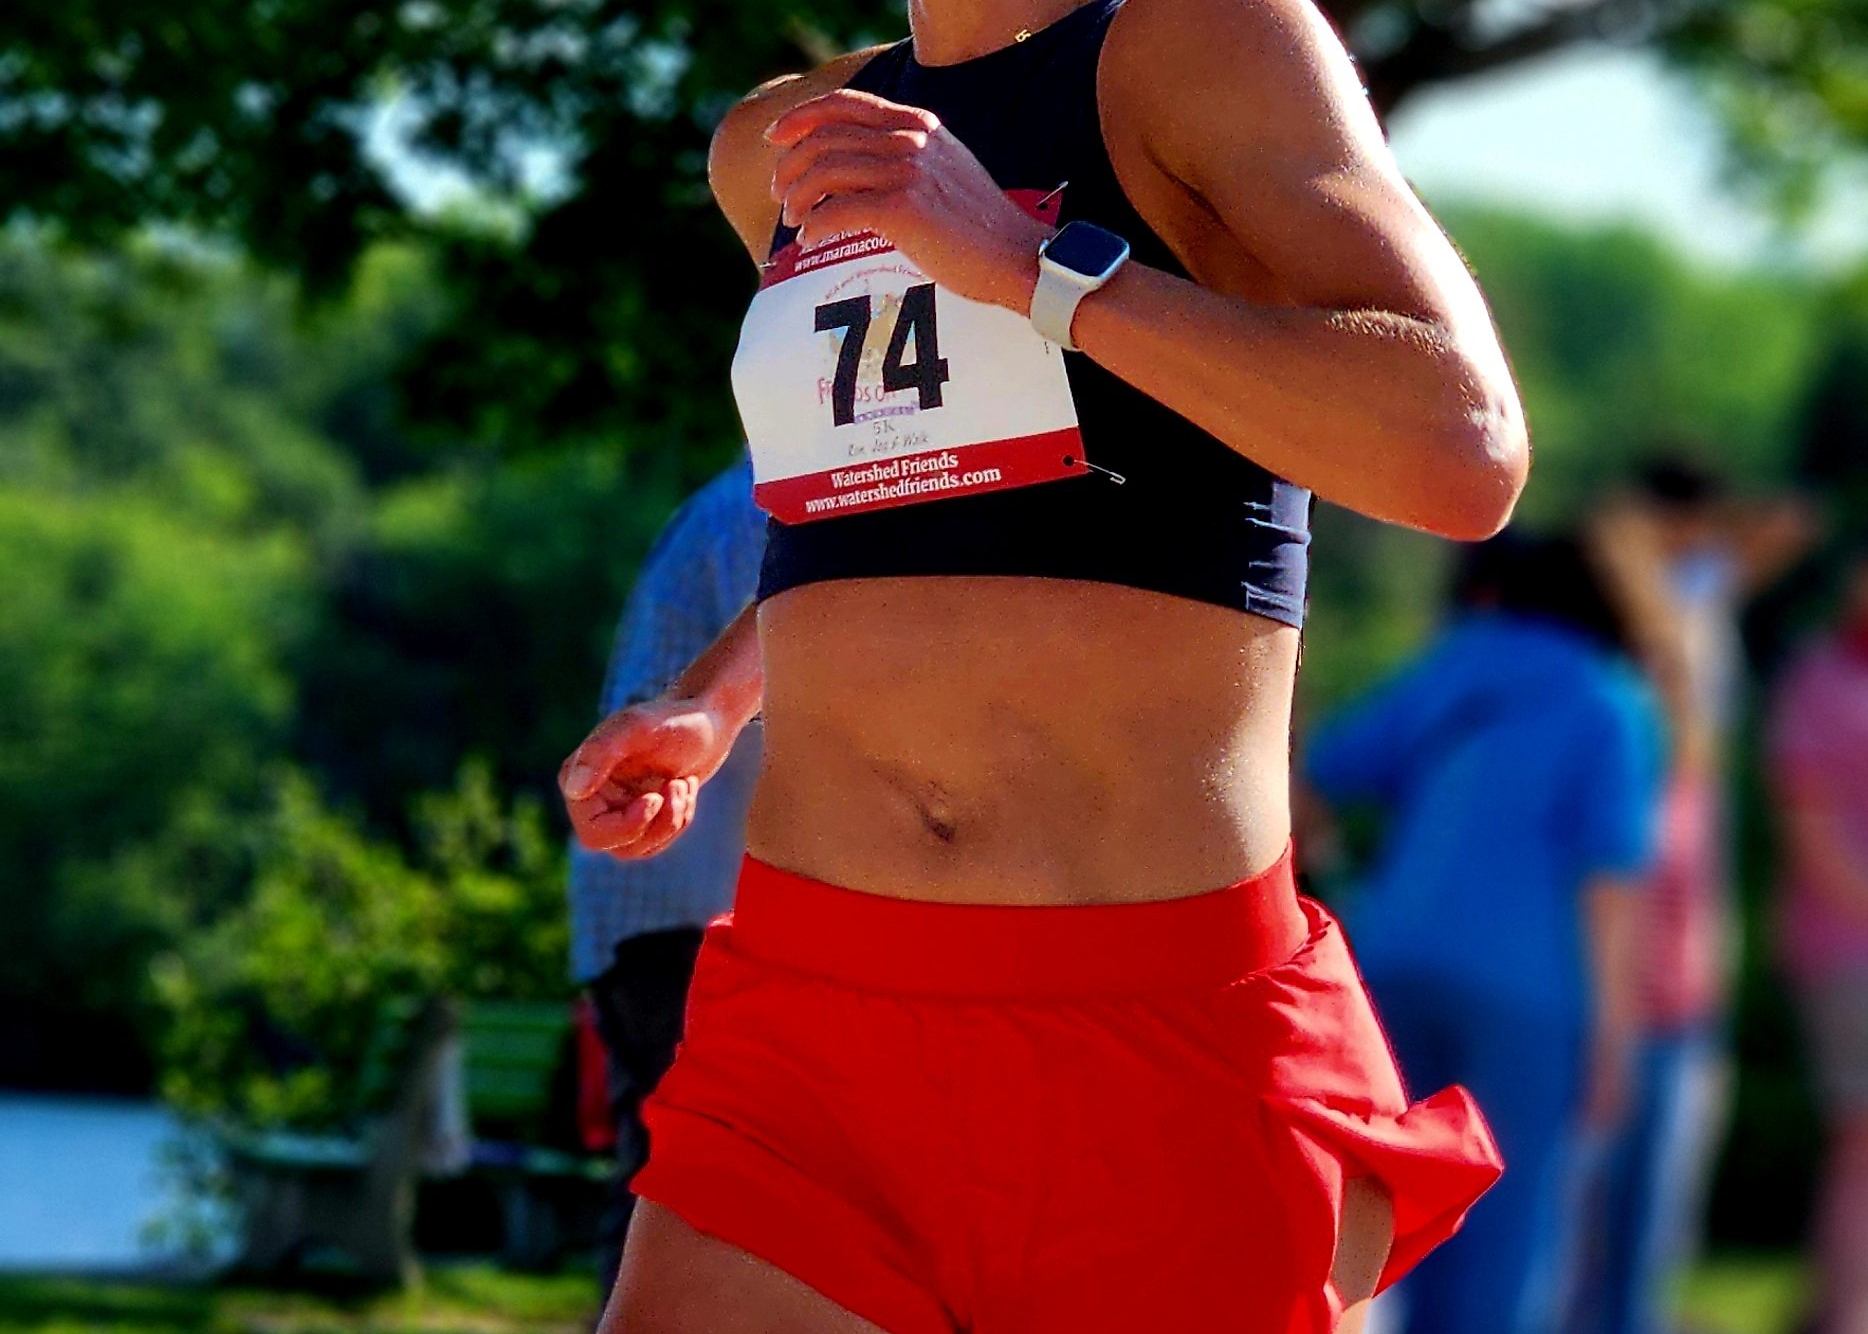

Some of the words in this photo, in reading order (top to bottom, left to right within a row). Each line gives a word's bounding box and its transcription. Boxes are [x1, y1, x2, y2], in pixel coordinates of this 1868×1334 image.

[794, 235, 893, 272] www.maranacoo
[813, 281, 950, 427] 74
[805, 467, 1002, 513] www.watershedfriends.com
[831, 460, 900, 488] Watershed
[901, 451, 959, 477] Friends
